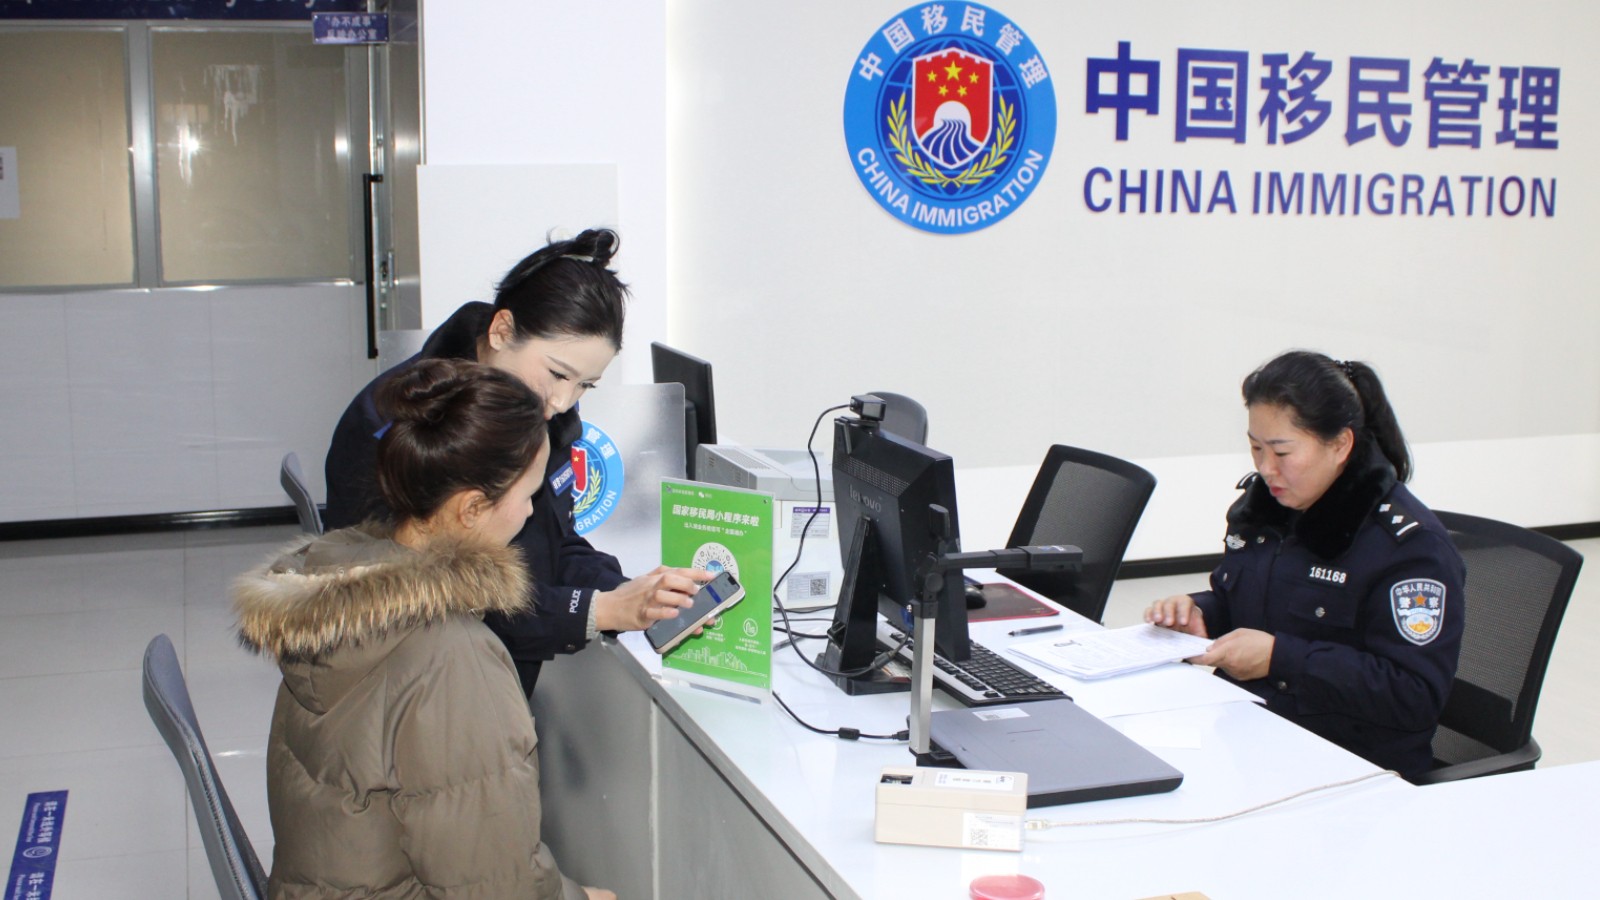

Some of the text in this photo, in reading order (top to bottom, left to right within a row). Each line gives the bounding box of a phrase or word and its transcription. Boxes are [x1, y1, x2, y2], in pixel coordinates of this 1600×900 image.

[859, 4, 1048, 88] 中国移民管理
[1086, 41, 1560, 149] 中国移民管理
[858, 148, 1044, 227] CHINA IMMIGRATION
[1083, 167, 1557, 217] CHINA IMMIGRATION
[574, 489, 617, 531] GRATION
[1309, 566, 1347, 584] 161168
[1395, 582, 1442, 596] 中华人民共和国
